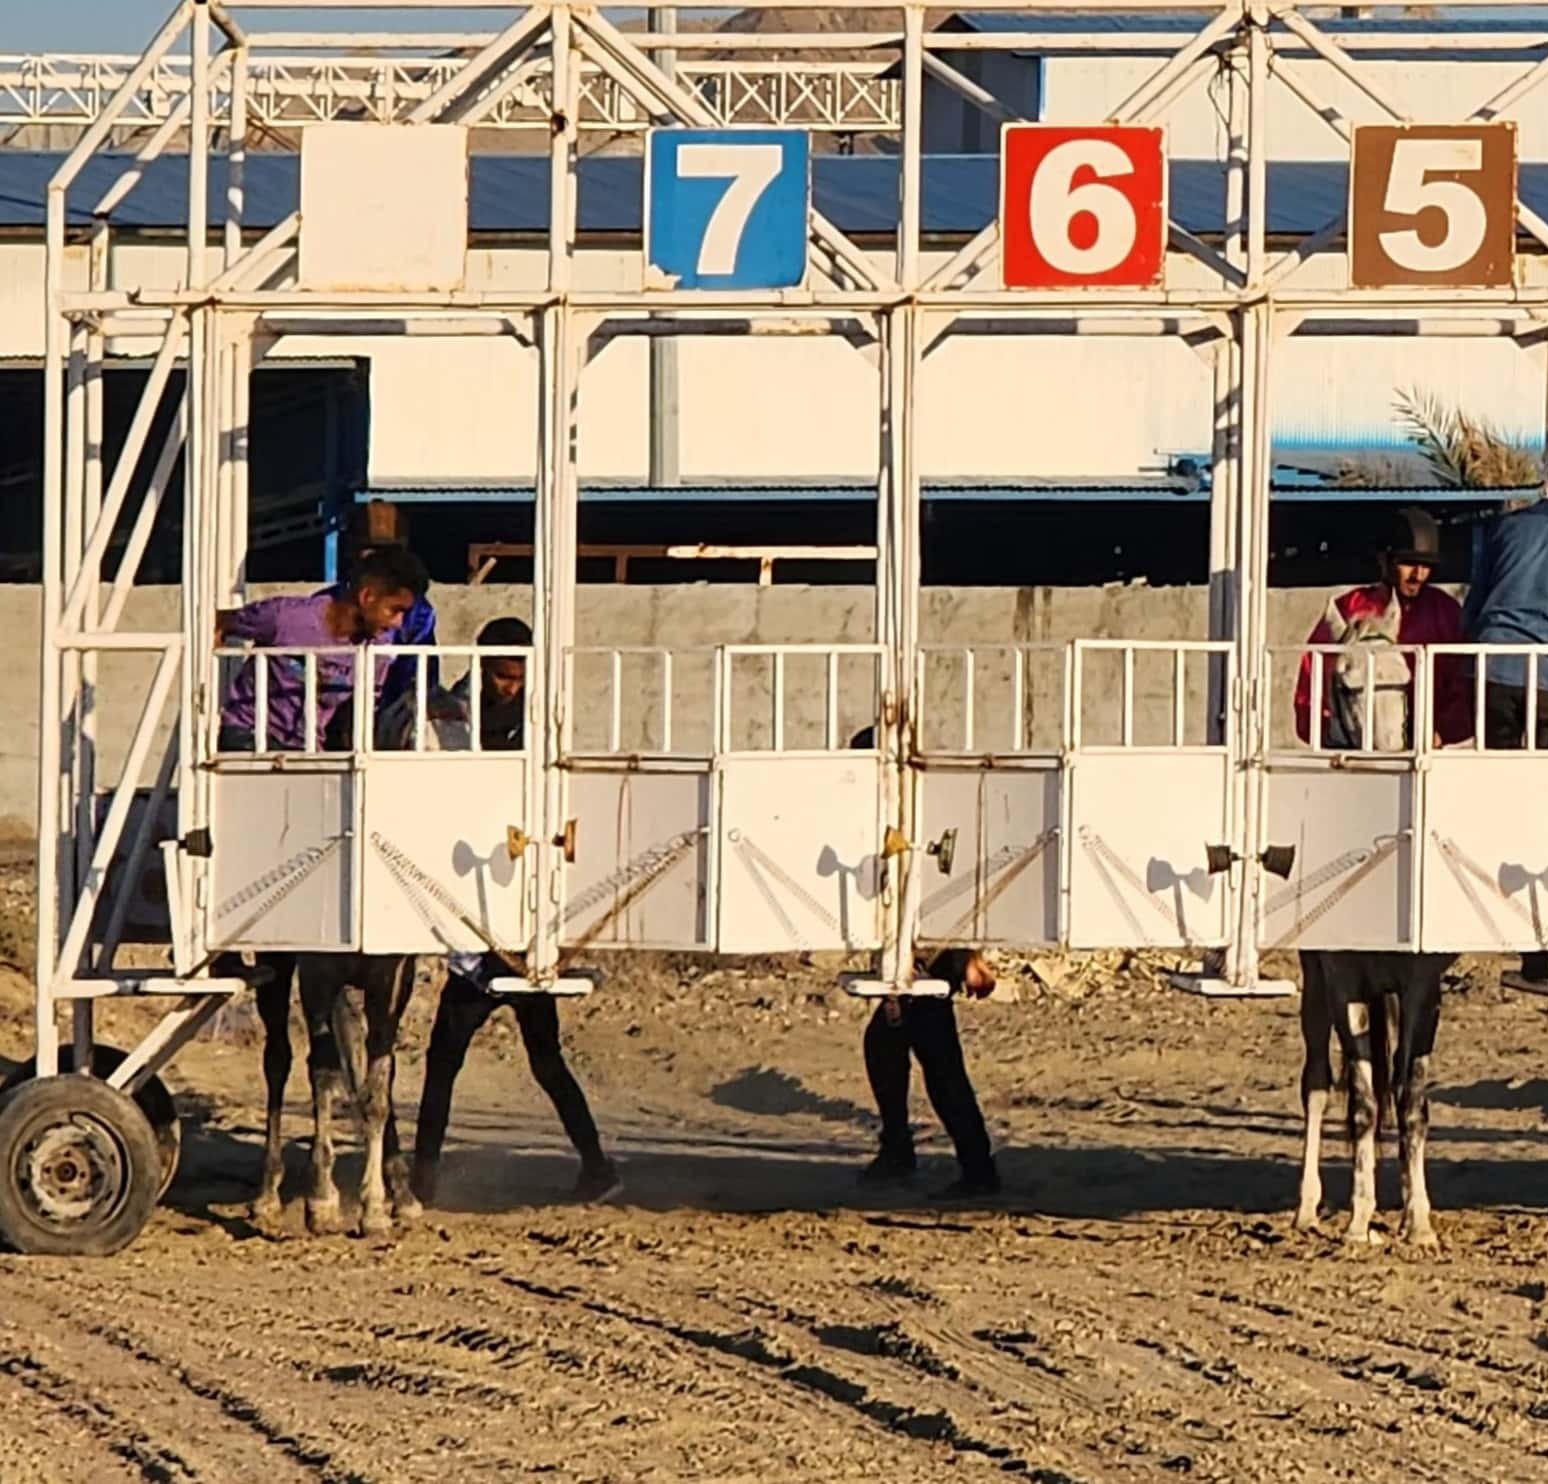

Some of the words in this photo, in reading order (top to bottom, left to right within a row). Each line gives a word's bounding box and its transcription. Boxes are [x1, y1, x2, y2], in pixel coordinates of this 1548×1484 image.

[677, 144, 782, 275] 7
[1031, 140, 1135, 273] 6
[1380, 140, 1486, 271] 5
